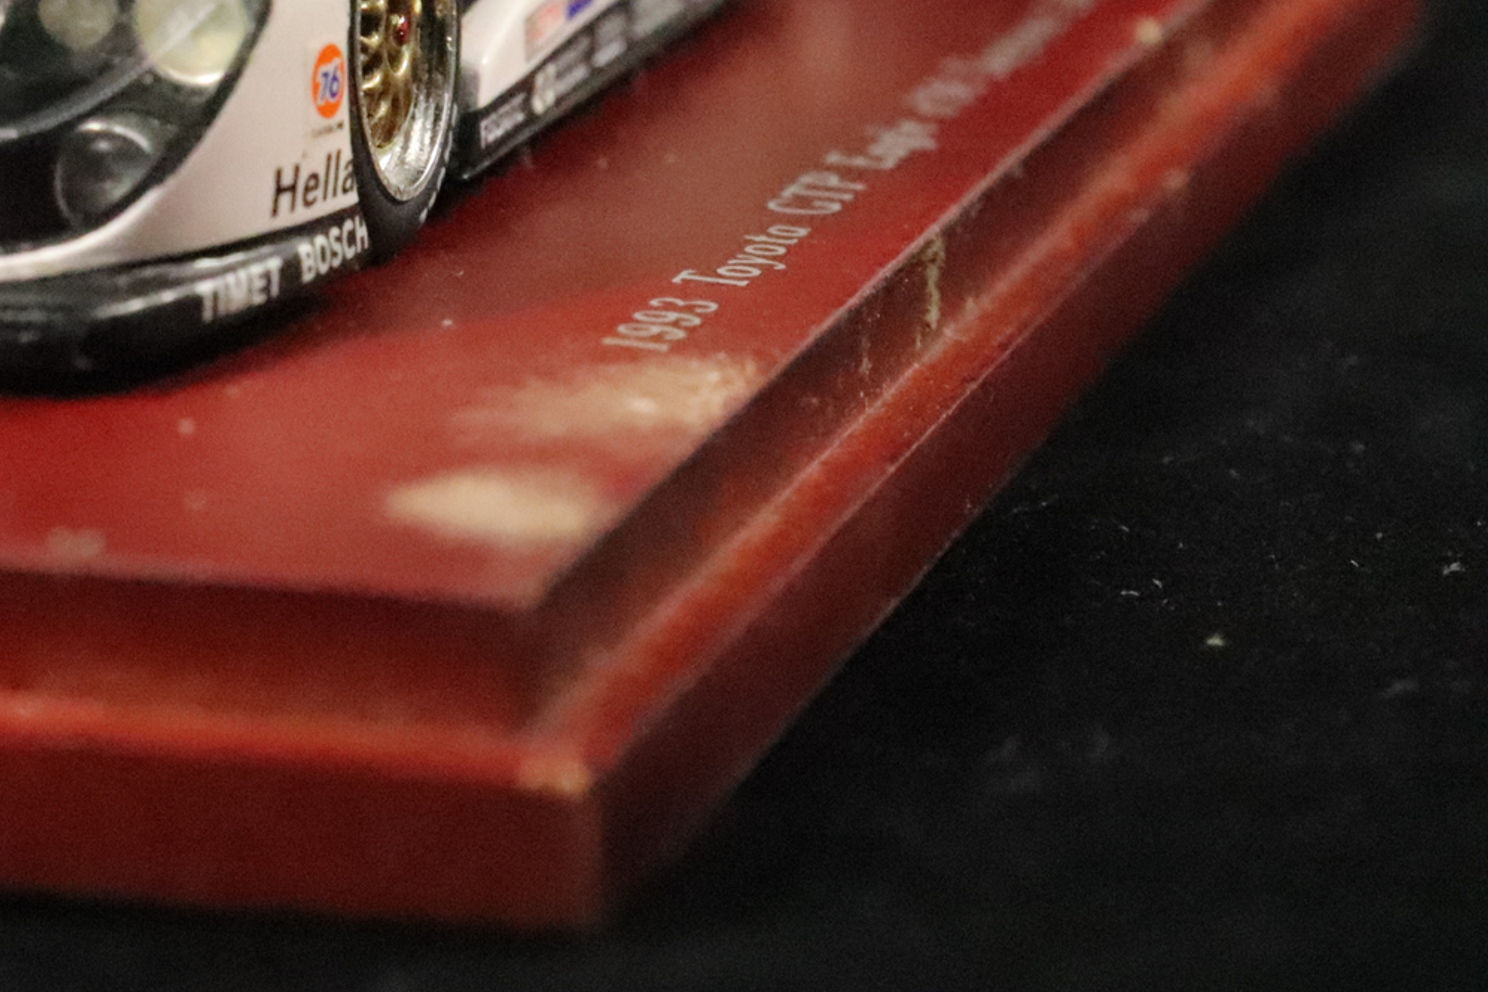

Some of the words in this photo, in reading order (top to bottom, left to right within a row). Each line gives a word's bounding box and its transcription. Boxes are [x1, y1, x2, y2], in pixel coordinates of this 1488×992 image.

[272, 148, 355, 219] Hella
[297, 215, 369, 284] BOSCH
[602, 296, 719, 352] 1993
[671, 224, 811, 287] Toyota
[767, 171, 867, 215] GTP
